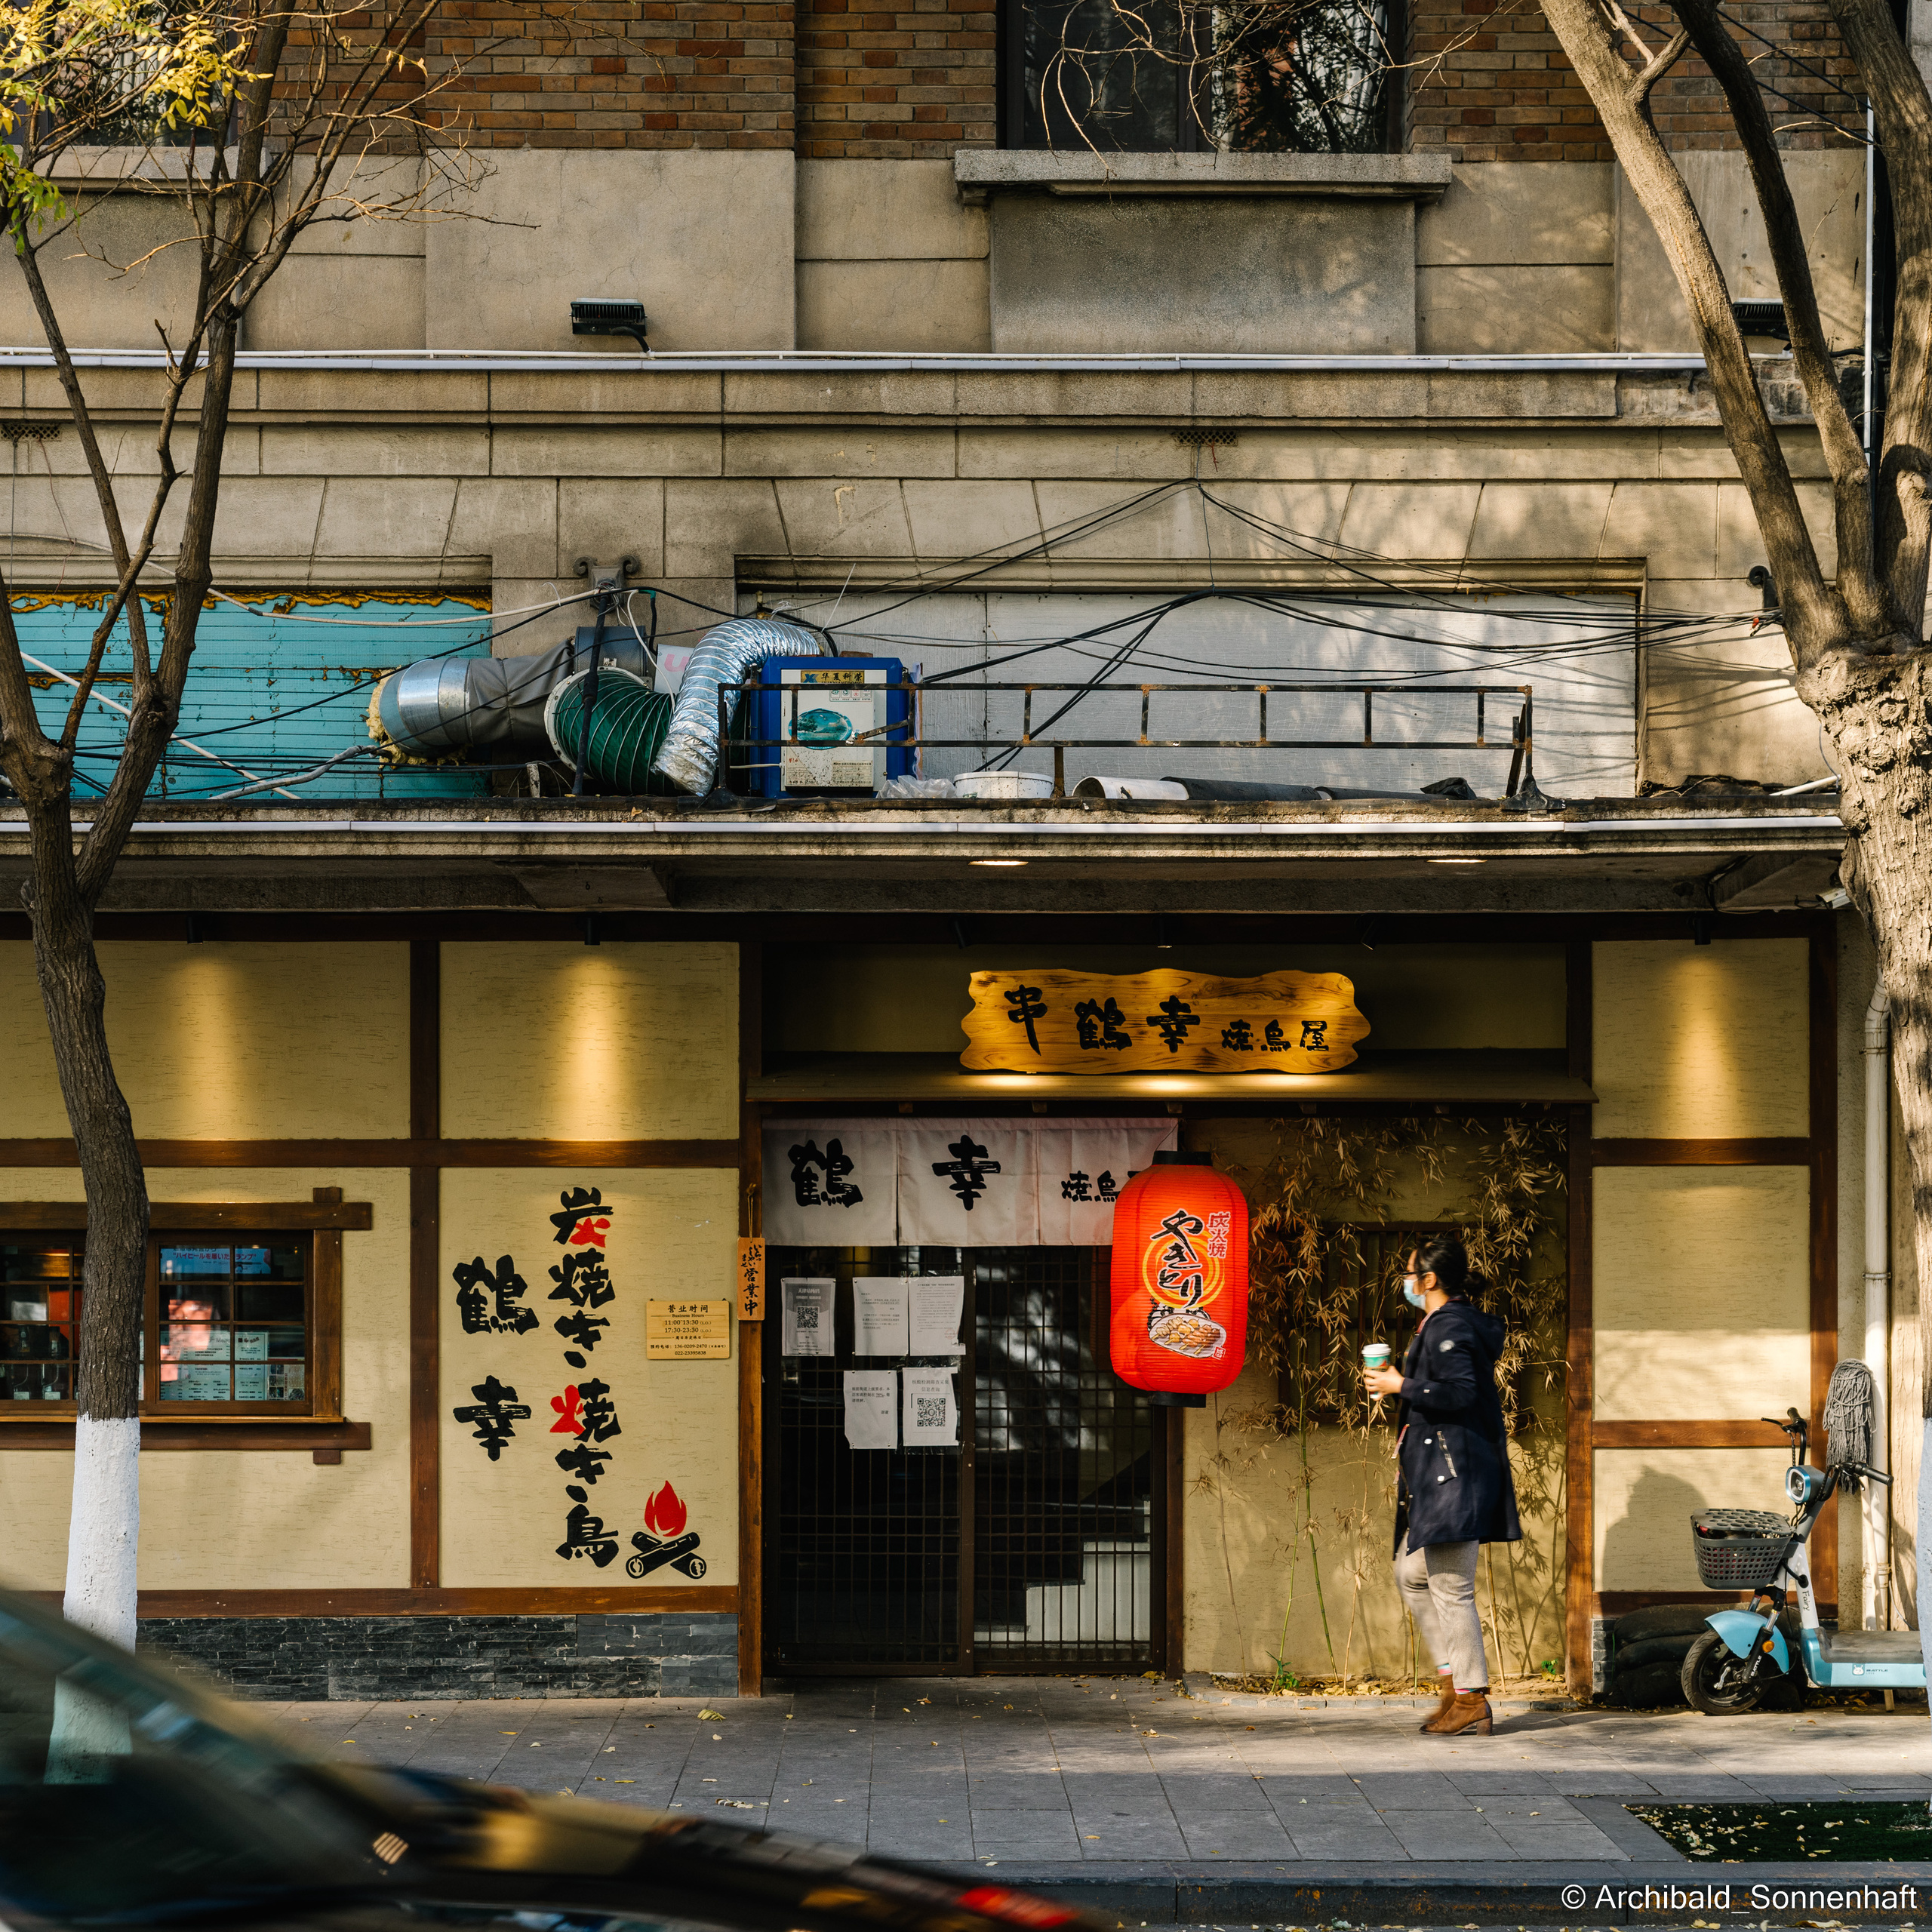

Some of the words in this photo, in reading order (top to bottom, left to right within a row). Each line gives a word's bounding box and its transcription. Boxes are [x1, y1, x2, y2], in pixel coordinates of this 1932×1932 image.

[821, 672, 863, 681] 华夏科荣
[1207, 1212, 1231, 1259] 炭火焼
[1151, 1208, 1204, 1309] やきとり
[667, 1304, 709, 1313] 营业时间
[1802, 1590, 1810, 1611] Fairy
[1751, 1655, 1762, 1677] BATTLE
